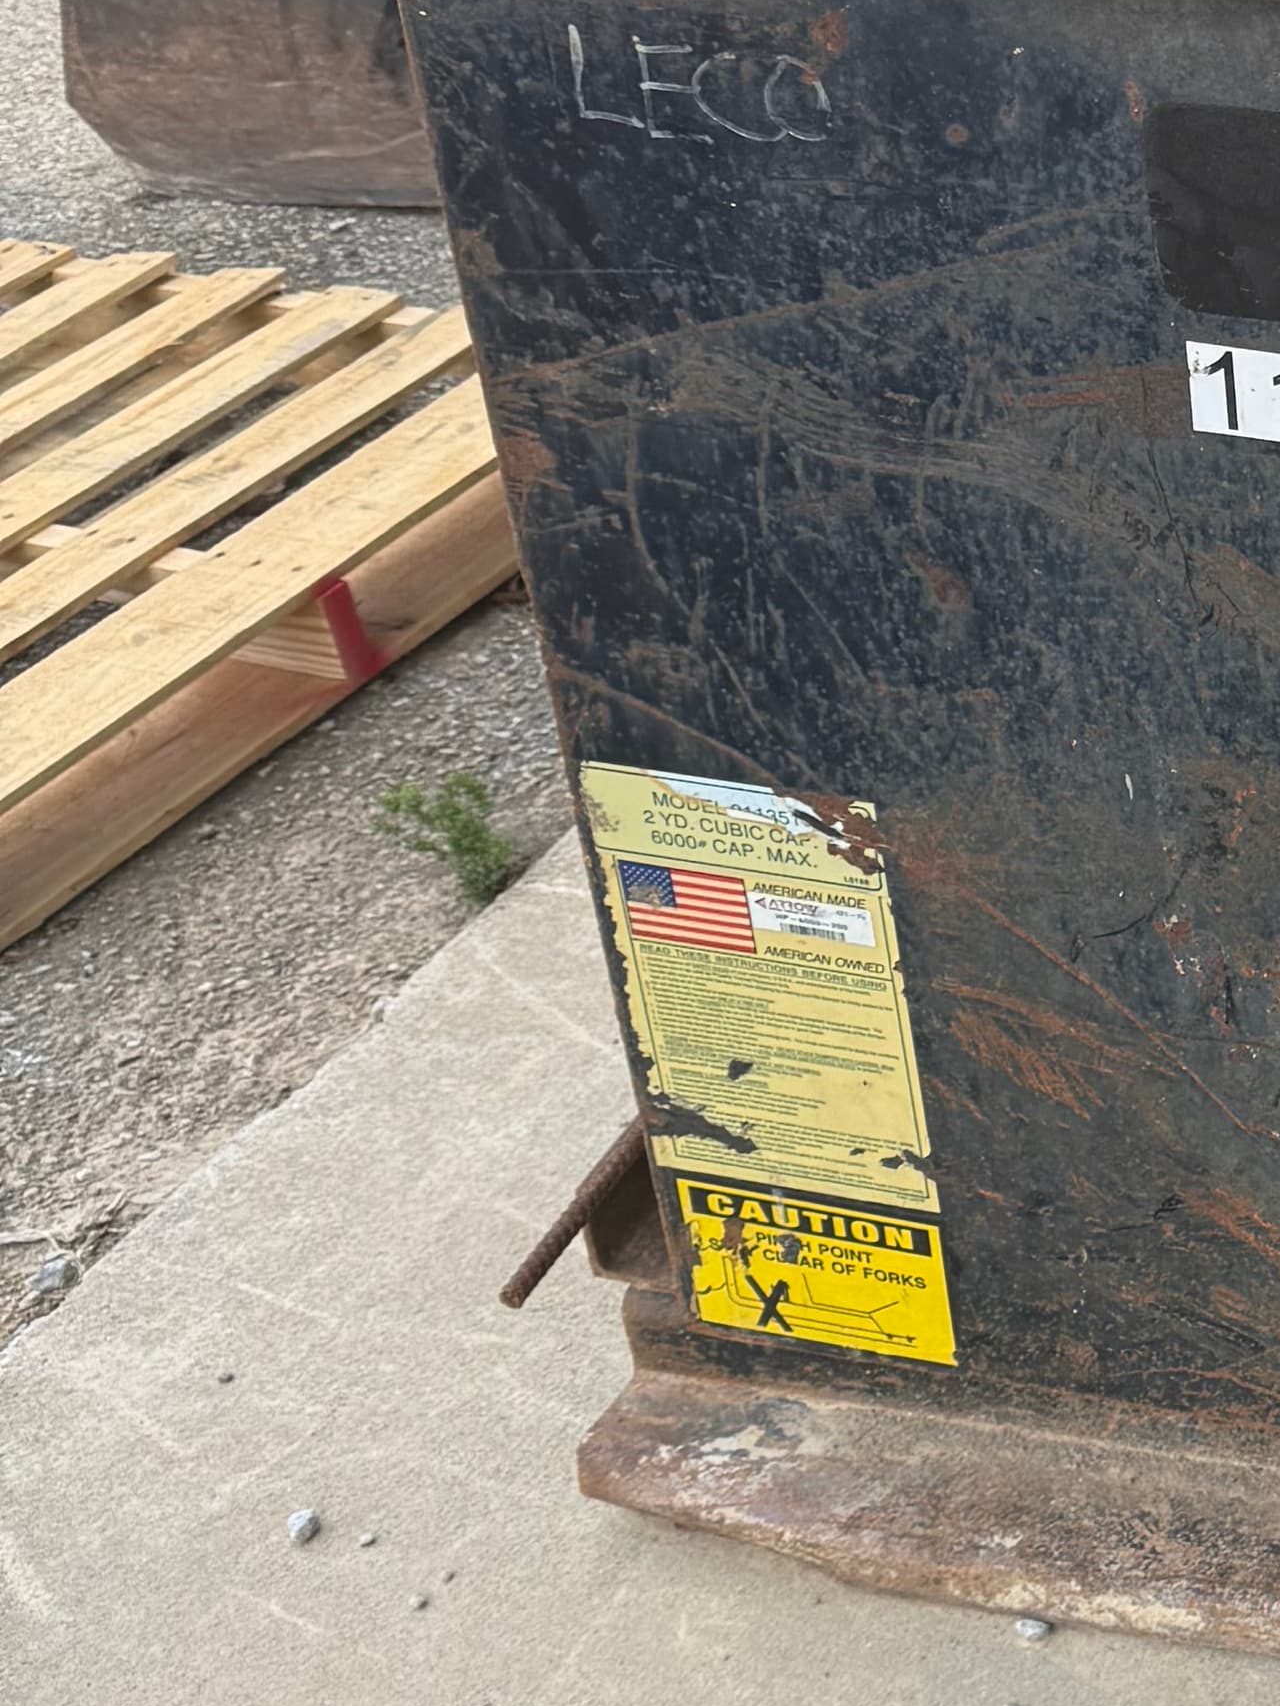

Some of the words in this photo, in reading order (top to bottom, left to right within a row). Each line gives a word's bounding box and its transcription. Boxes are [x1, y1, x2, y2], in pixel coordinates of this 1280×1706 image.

[652, 792, 727, 816] MODEL
[643, 809, 656, 824] 2
[699, 817, 765, 842] CUBIC
[766, 847, 819, 869] MAX.
[752, 881, 823, 904] AMERICAN
[827, 894, 867, 910] MADE
[674, 949, 712, 964] THESE
[714, 954, 798, 977] INSTRUCTIONS
[801, 969, 849, 985] BEFORE
[851, 976, 888, 992] USING
[763, 945, 832, 966] AMERICAN
[834, 956, 885, 974] OWNED
[706, 1192, 915, 1251] CAUTION
[755, 1231, 812, 1253] PIH
[818, 1243, 873, 1264] POINT
[762, 1249, 825, 1271] CLAR
[831, 1261, 856, 1275] OF
[862, 1264, 928, 1290] FORKS
